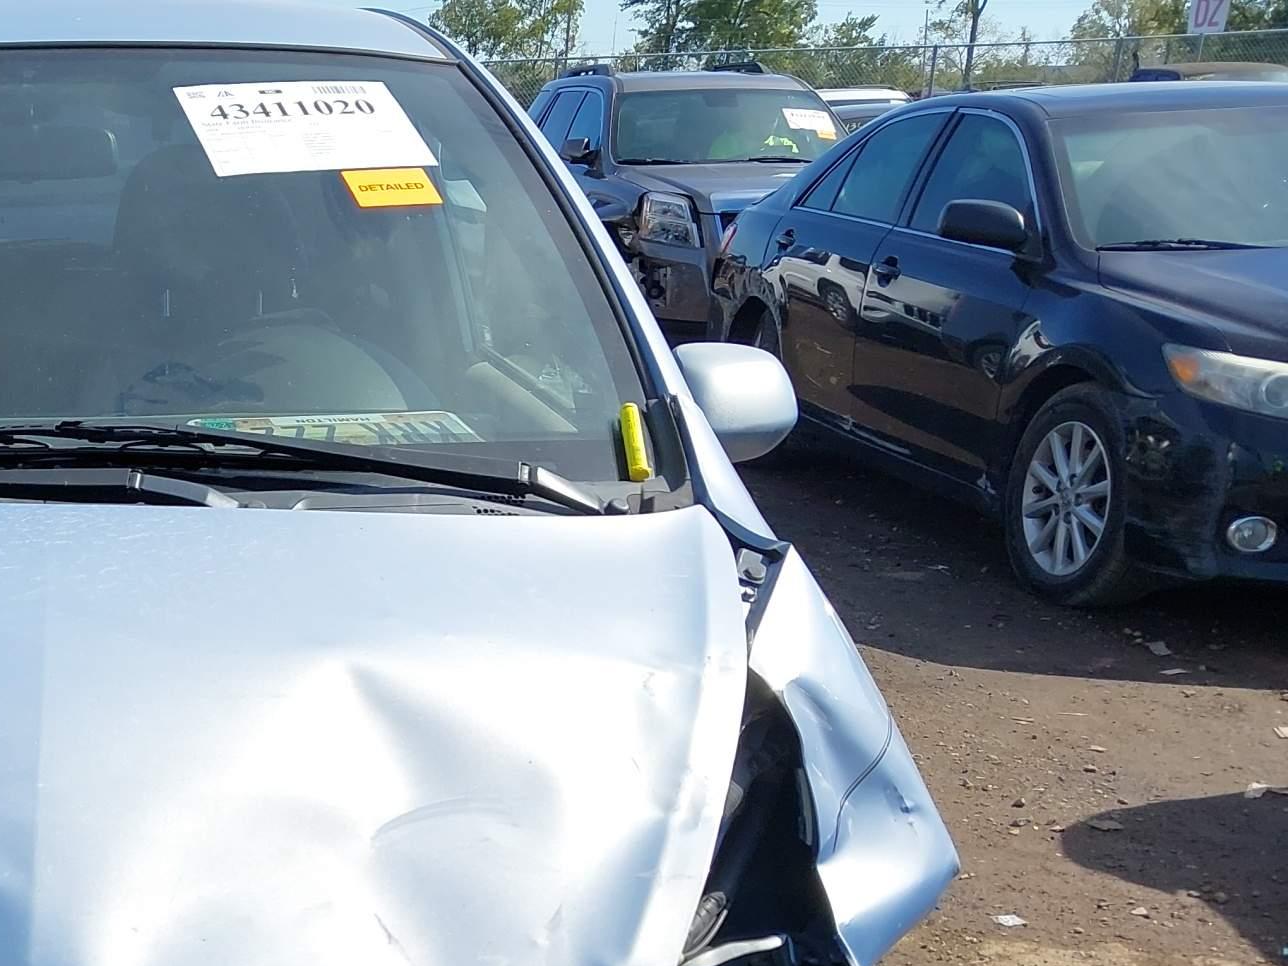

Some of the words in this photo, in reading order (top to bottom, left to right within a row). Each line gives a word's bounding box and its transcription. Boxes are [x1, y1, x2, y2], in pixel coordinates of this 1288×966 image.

[209, 98, 376, 120] 43411020
[358, 181, 425, 193] DETAILED
[295, 416, 371, 425] HAMILTON
